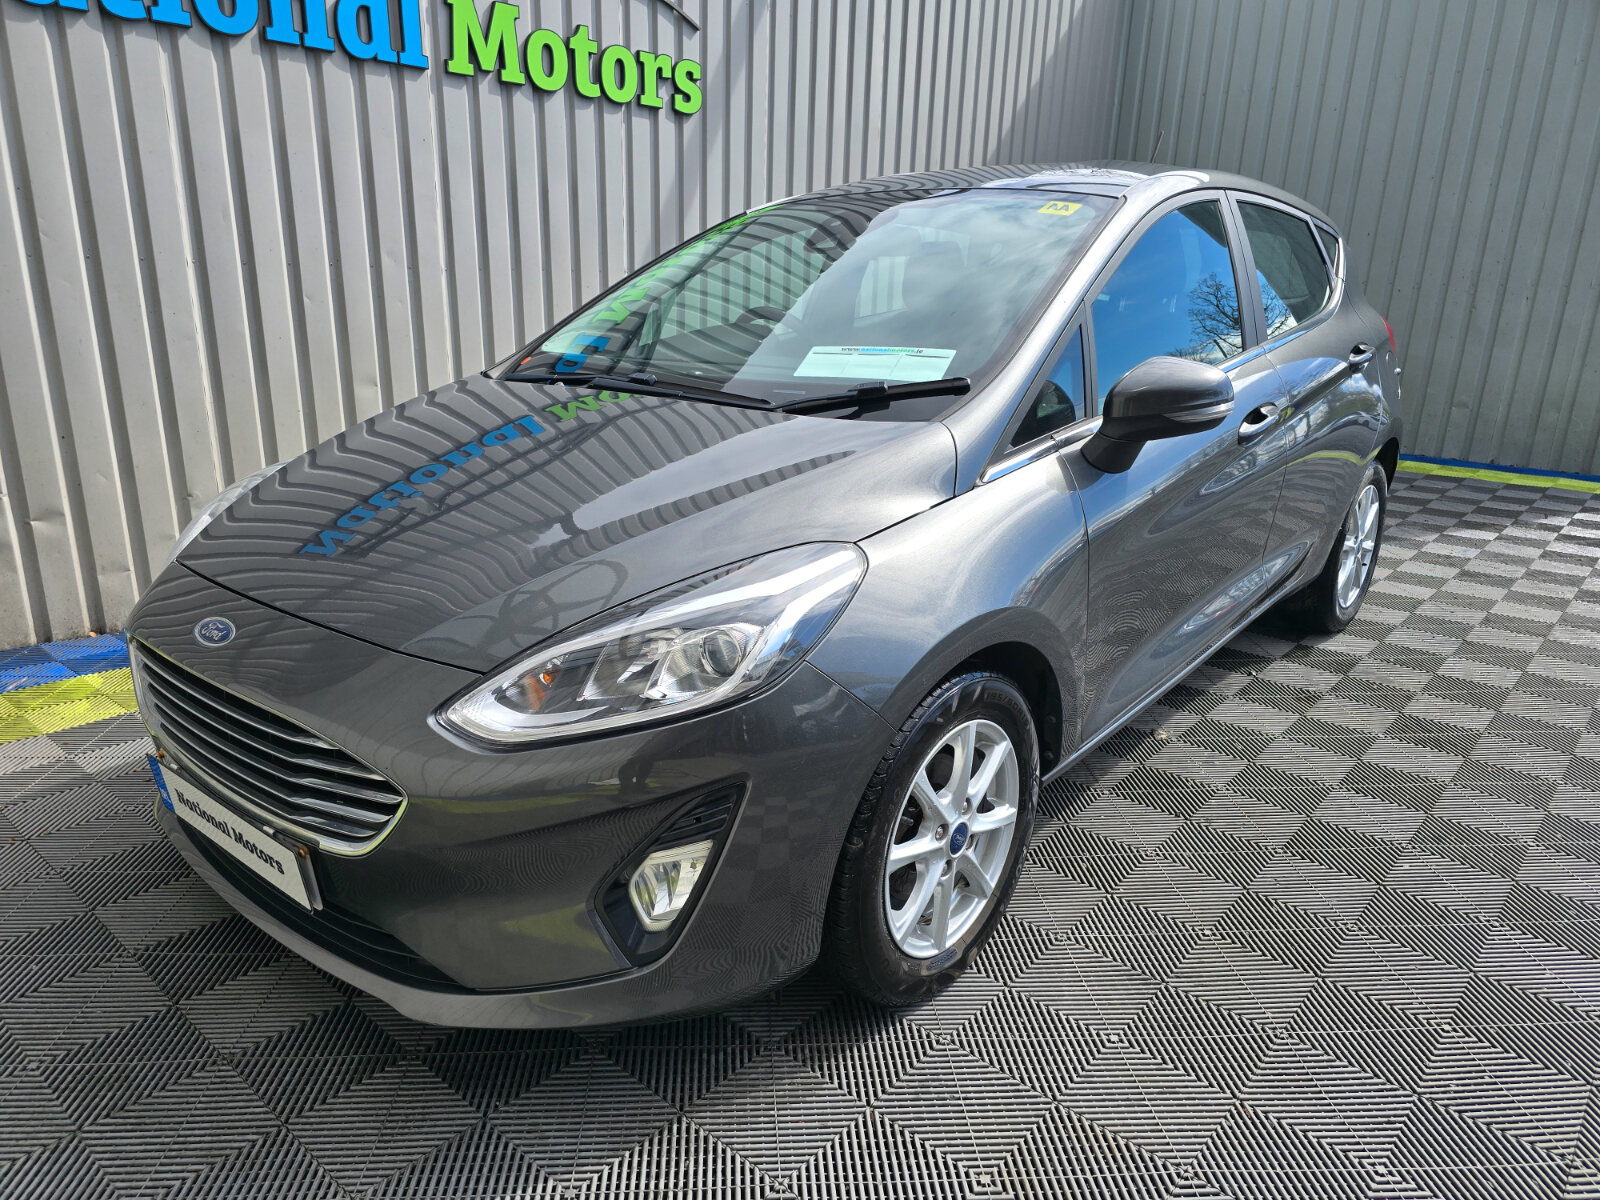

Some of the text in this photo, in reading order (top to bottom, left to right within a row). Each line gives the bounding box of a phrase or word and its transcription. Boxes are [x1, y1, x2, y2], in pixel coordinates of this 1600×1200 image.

[447, 0, 704, 115] Motors
[1047, 203, 1070, 212] AA
[174, 787, 285, 876] National Motors
